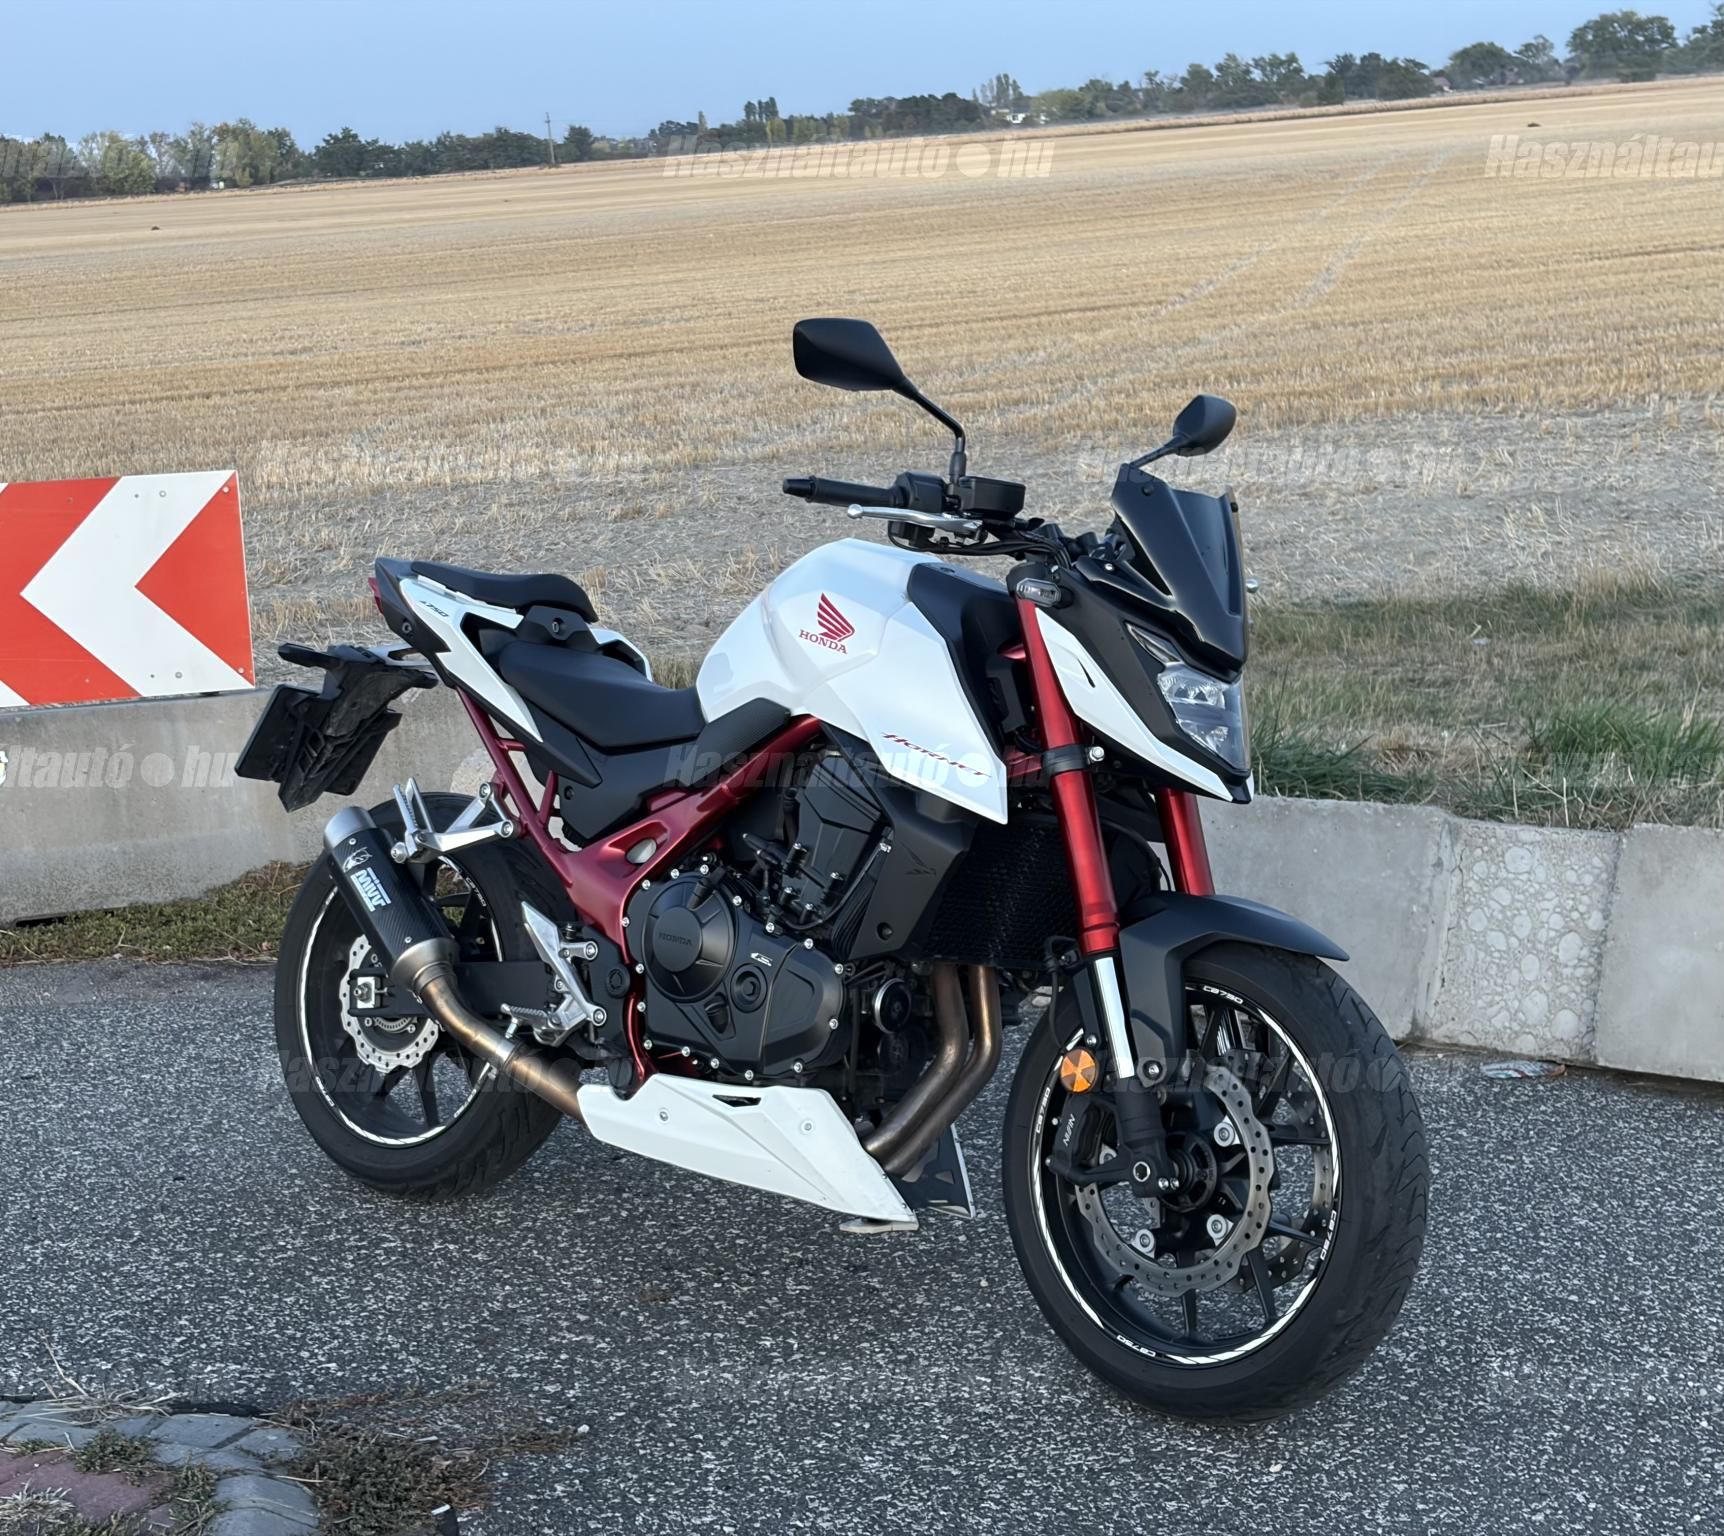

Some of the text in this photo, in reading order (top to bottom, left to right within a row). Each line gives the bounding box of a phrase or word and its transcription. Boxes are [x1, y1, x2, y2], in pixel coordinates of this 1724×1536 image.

[799, 629, 848, 655] HONDA
[352, 868, 390, 910] MIVV
[658, 932, 692, 946] HONDA
[1202, 985, 1244, 1005] CB750
[1035, 1086, 1051, 1134] CB750
[1319, 1209, 1337, 1261] CB750
[1116, 1334, 1157, 1358] CB750
